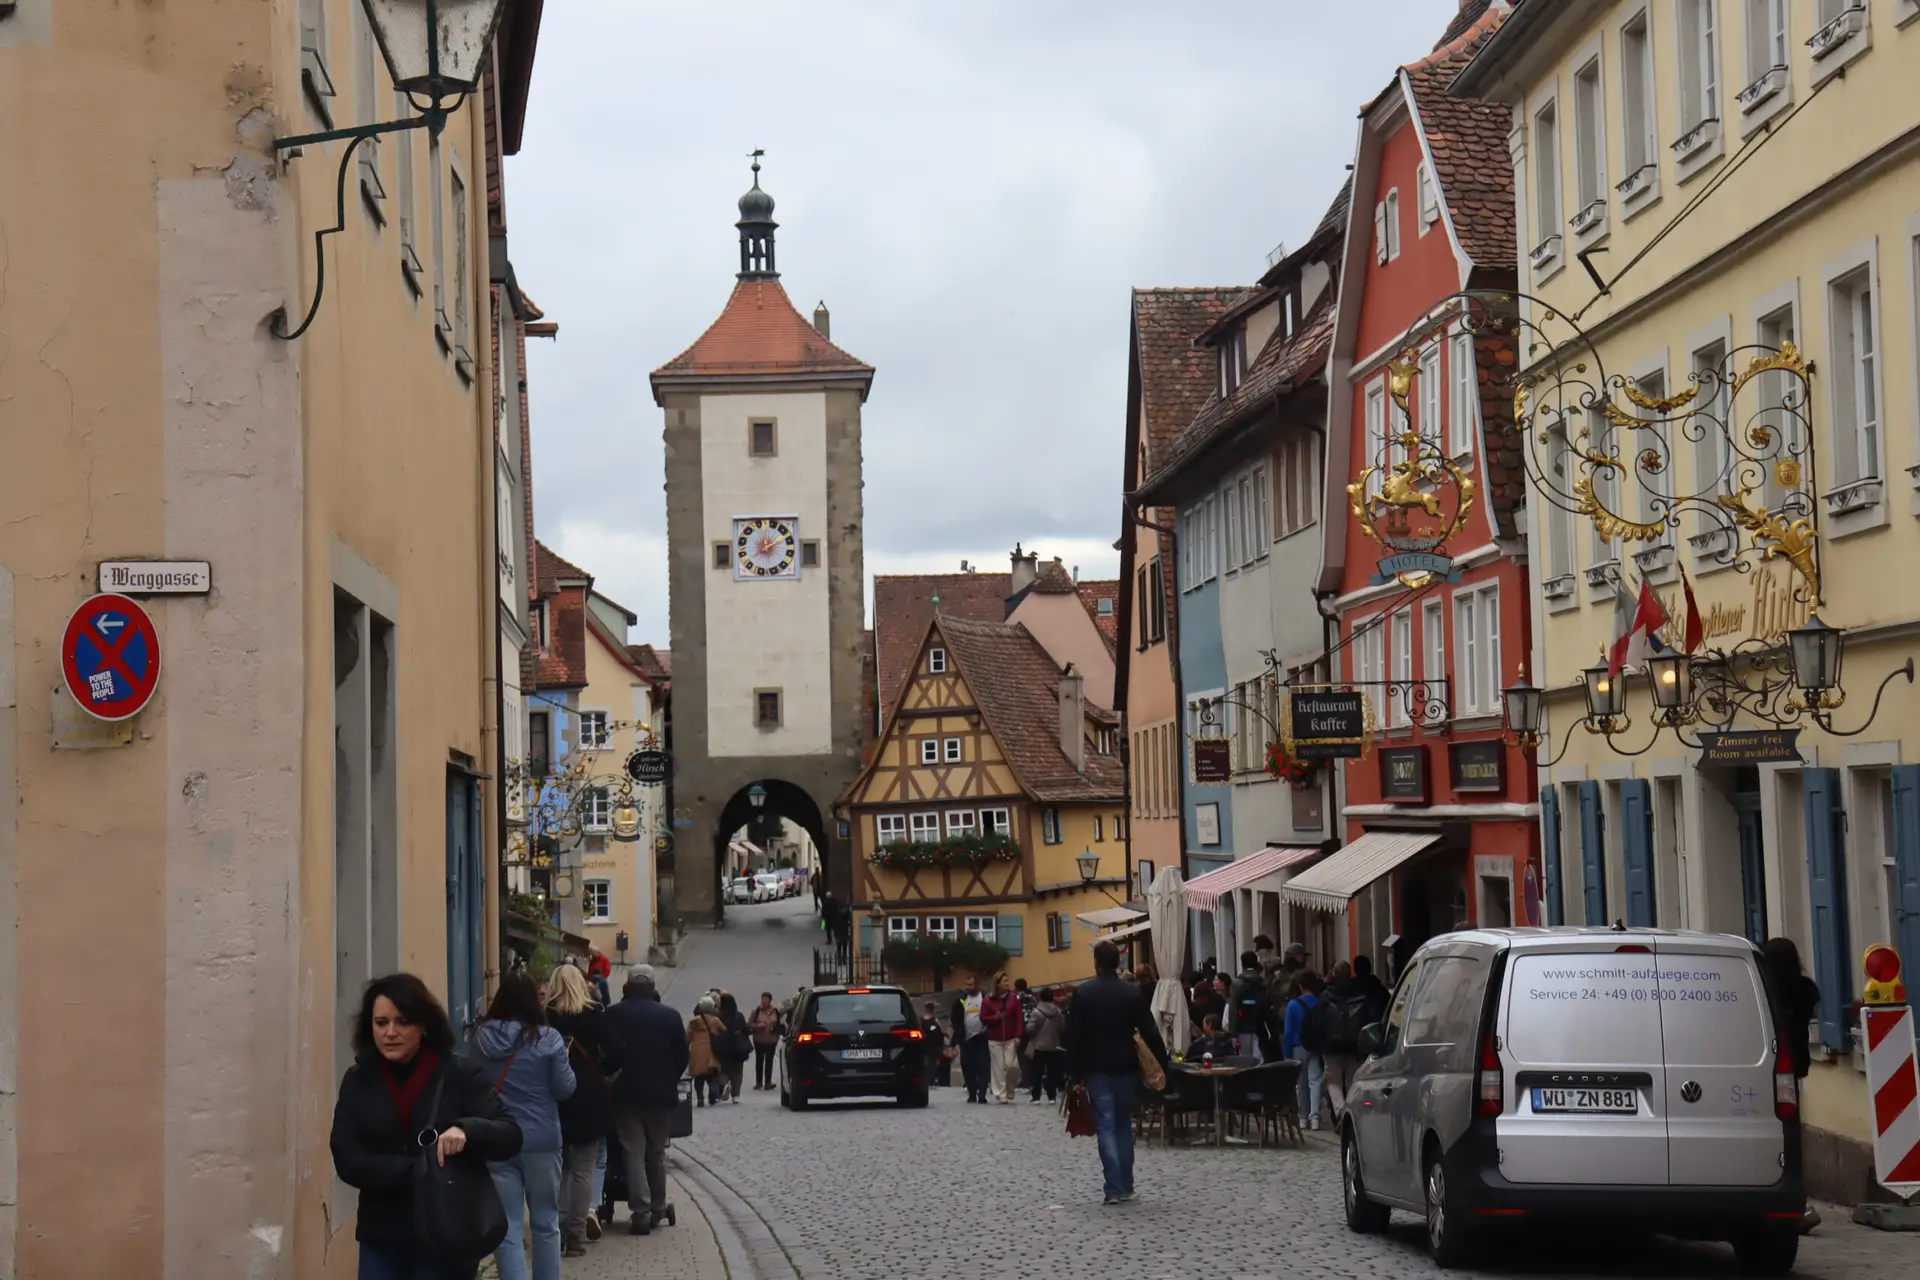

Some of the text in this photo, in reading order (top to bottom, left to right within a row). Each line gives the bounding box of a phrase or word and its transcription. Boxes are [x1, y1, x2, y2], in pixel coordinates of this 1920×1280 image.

[1390, 555, 1439, 570] HOTEL
[111, 567, 199, 590] Wenggasse
[89, 670, 112, 684] POWER
[91, 678, 113, 691] TO THE
[92, 686, 115, 700] PEOPLE
[1311, 717, 1348, 731] Kaffee
[1716, 735, 1782, 747] Zimmer frei
[1709, 747, 1791, 759] Room available
[636, 763, 665, 773] Hirsch
[1543, 968, 1721, 982] www.schmitt-aufzuege.com
[1530, 989, 1738, 1002] Service 24: +49 (0) 800 2400 365
[1543, 1091, 1566, 1107] WÜ
[1576, 1091, 1600, 1107] ZN
[1603, 1091, 1634, 1108] 881
